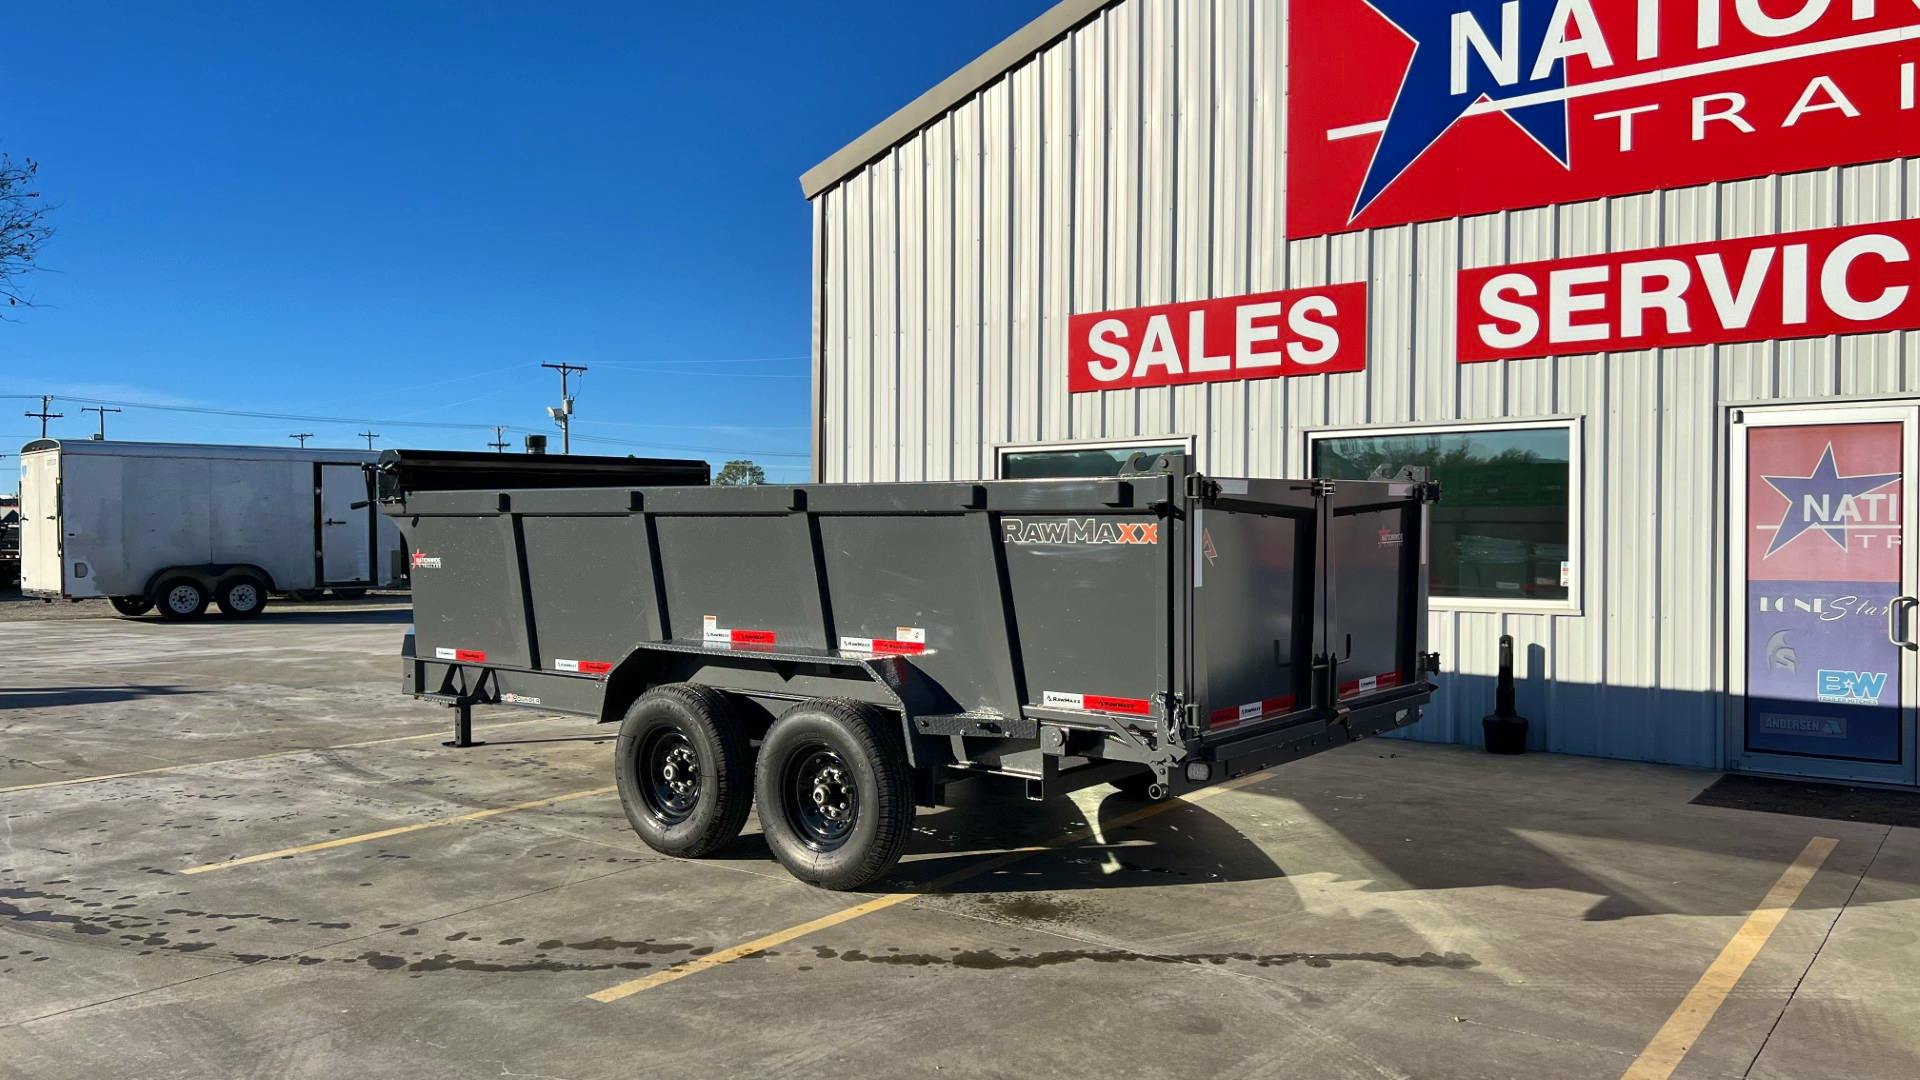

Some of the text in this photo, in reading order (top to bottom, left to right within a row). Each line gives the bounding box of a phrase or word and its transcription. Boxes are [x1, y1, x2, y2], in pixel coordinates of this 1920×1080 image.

[1450, 0, 1920, 96] NATI
[1593, 62, 1915, 152] TRAI
[1477, 233, 1911, 349] SERVIC
[1087, 295, 1340, 382] SALES
[1803, 493, 1897, 522] NATI
[1765, 716, 1820, 732] ANDERSEN
